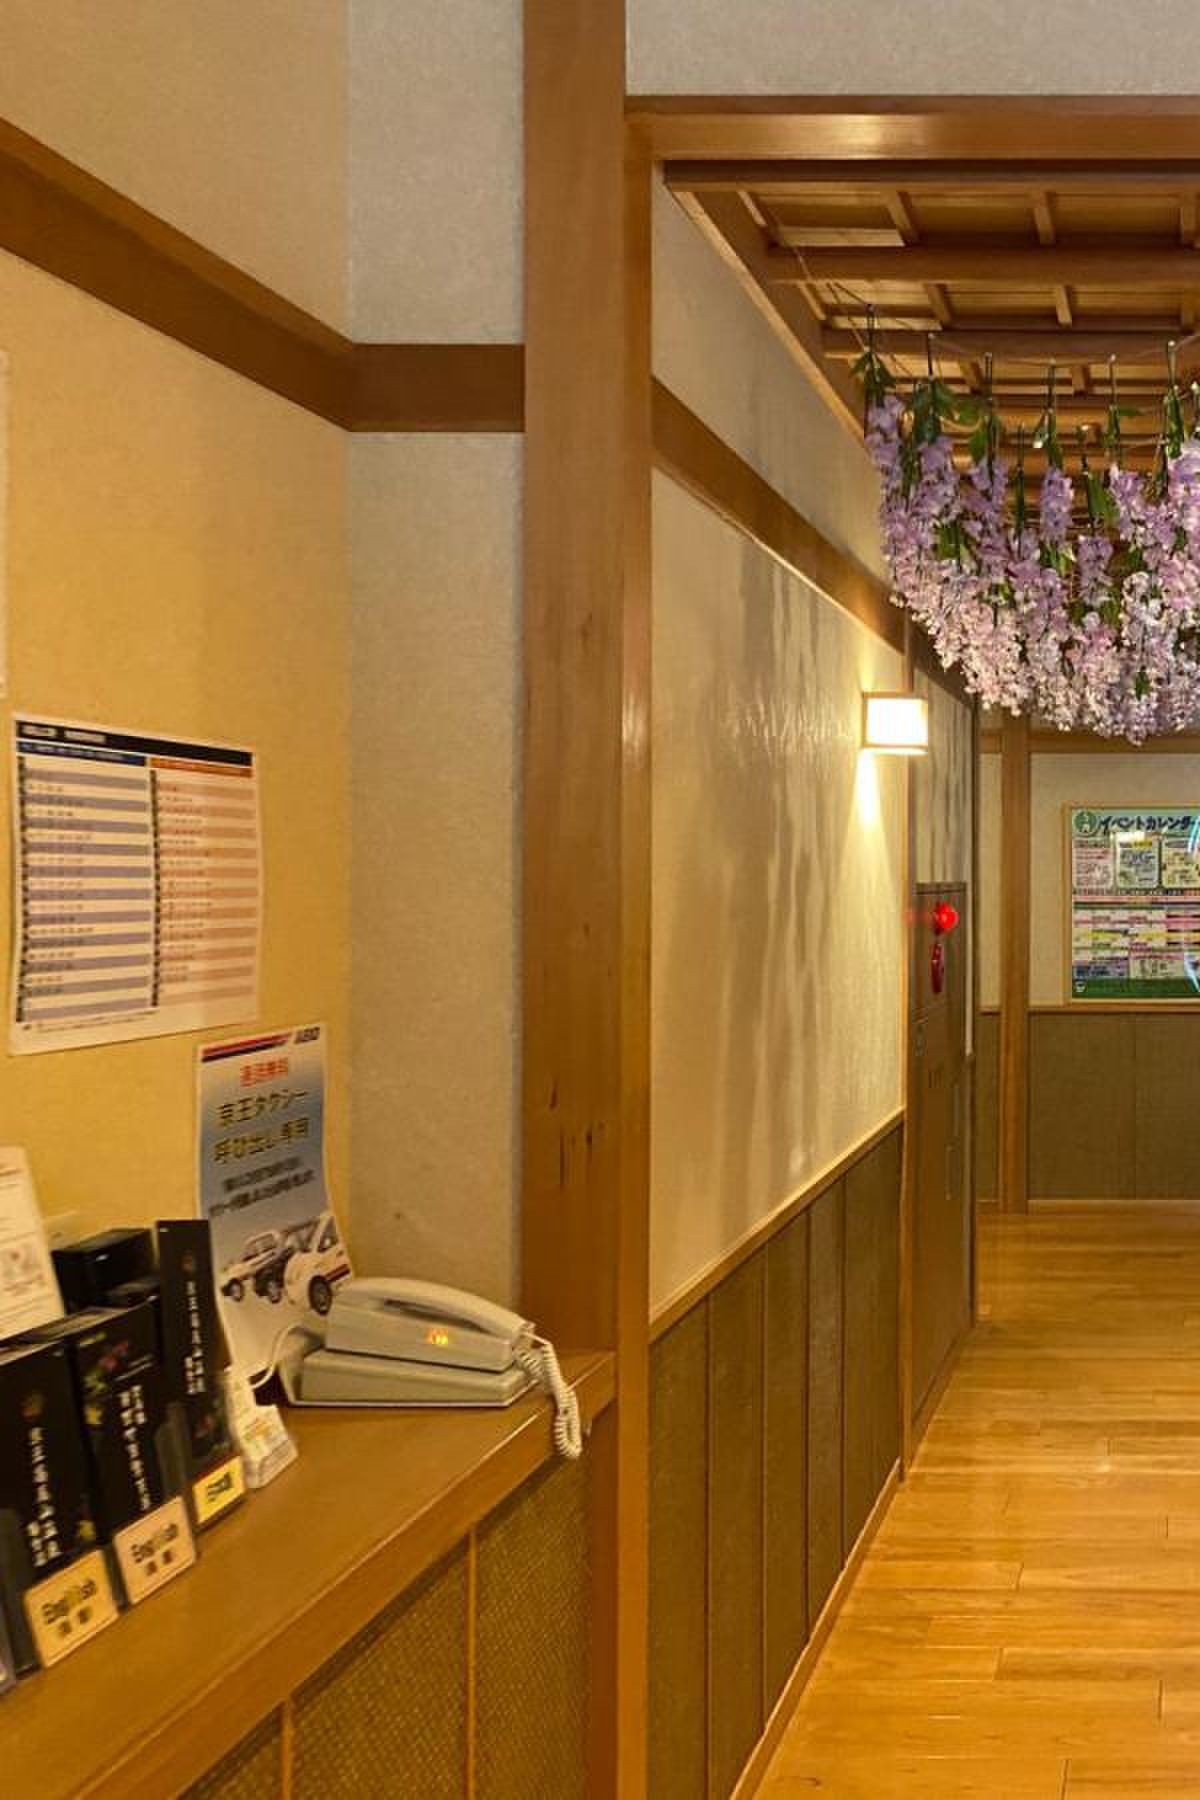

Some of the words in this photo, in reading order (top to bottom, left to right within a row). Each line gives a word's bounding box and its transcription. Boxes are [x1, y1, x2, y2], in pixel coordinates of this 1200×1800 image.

[216, 1088, 309, 1127] 京王タクシー
